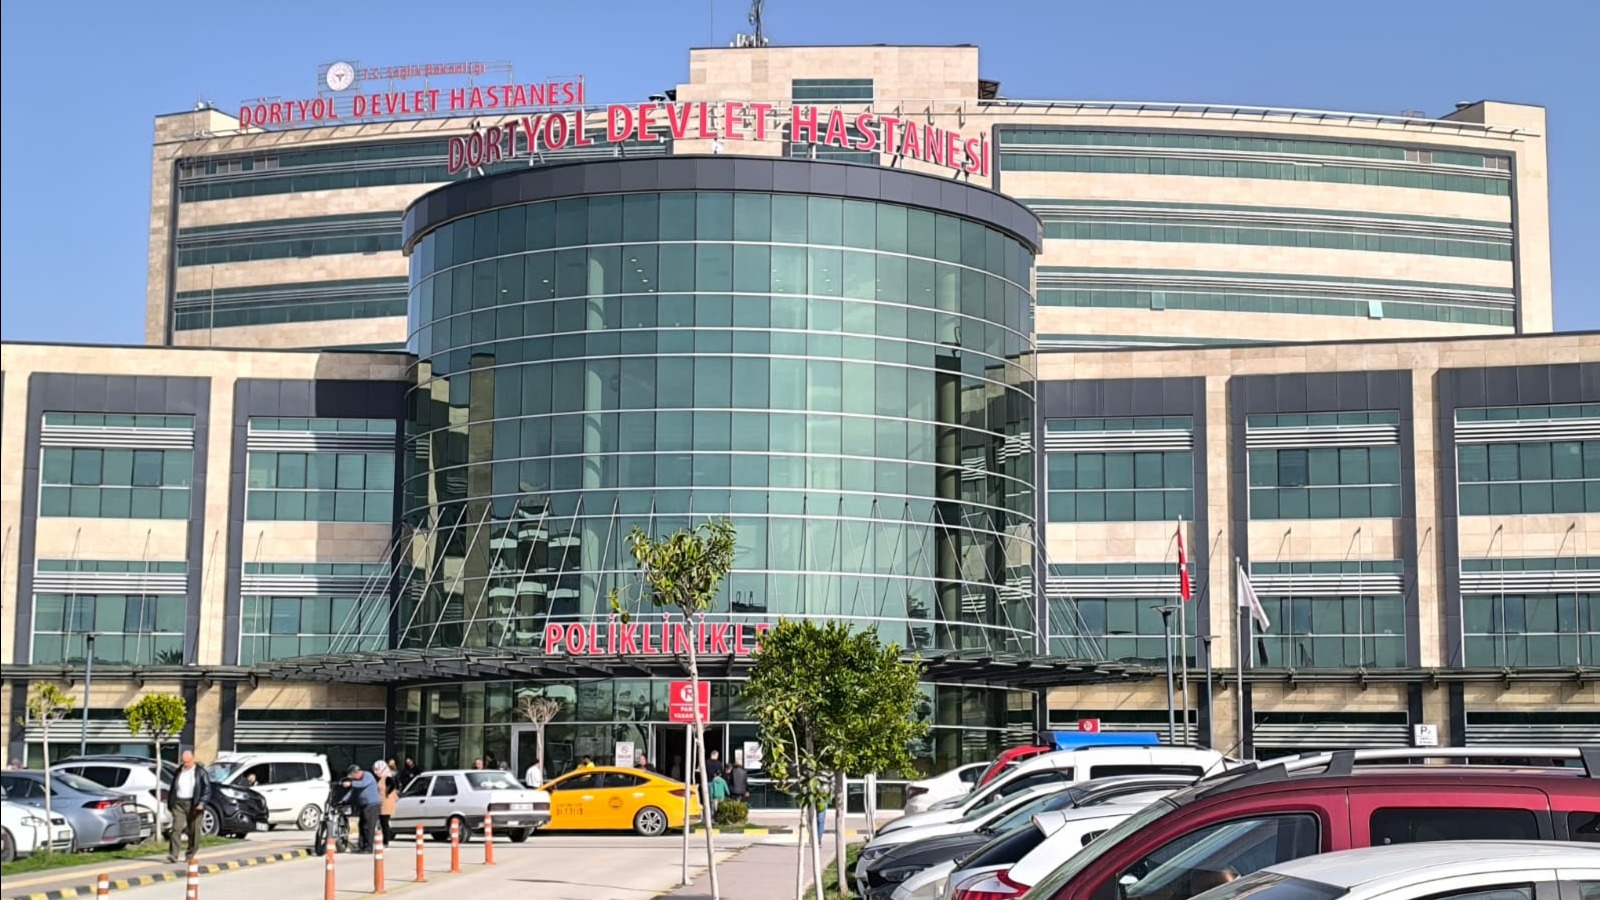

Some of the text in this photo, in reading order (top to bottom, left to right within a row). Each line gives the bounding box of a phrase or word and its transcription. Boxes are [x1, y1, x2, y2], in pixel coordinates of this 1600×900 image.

[239, 73, 584, 128] DÖRTYOL DEVLET HASTANESİ
[448, 103, 989, 176] DÖRTYOL DEVLET HASTANESİ
[545, 613, 770, 654] POLİKLİNİKLE
